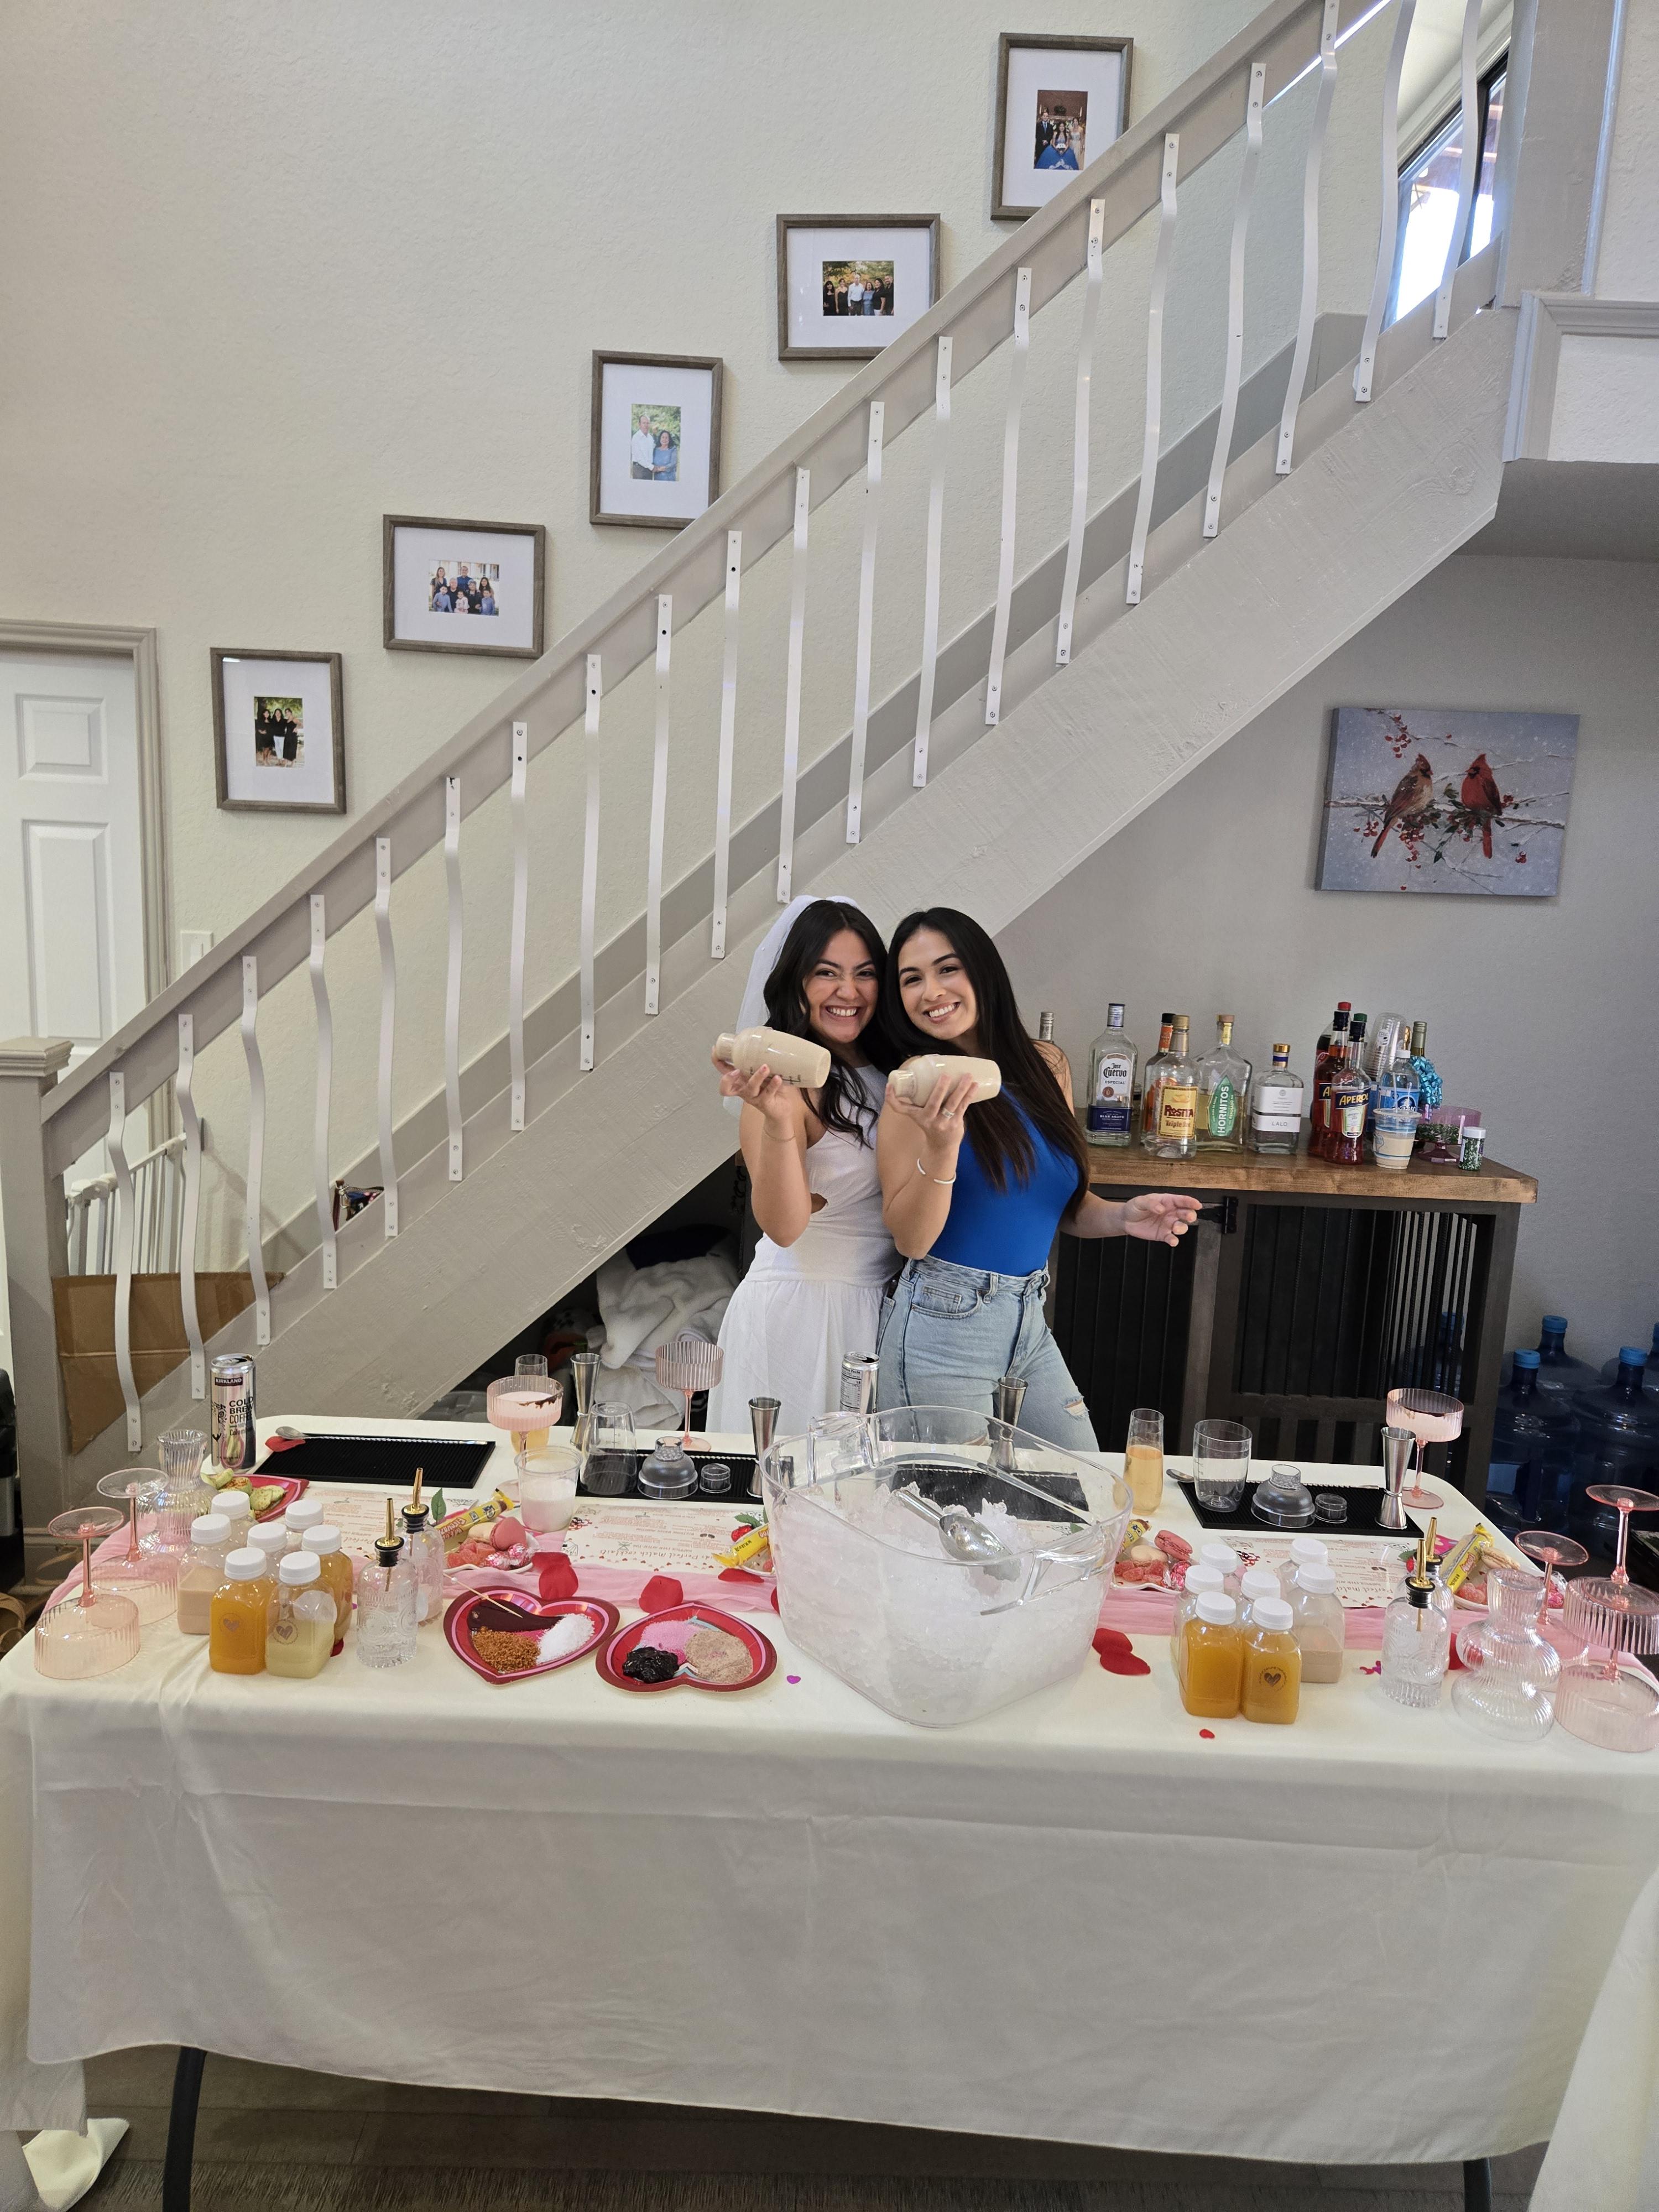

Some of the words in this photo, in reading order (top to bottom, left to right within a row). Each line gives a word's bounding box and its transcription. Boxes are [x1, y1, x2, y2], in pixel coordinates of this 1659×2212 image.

[1103, 1067, 1127, 1078] Cuervo
[1339, 1093, 1369, 1106] APEROL
[1217, 1086, 1230, 1134] HORNITOS
[229, 1396, 254, 1407] COLD
[229, 1403, 253, 1415] BREW
